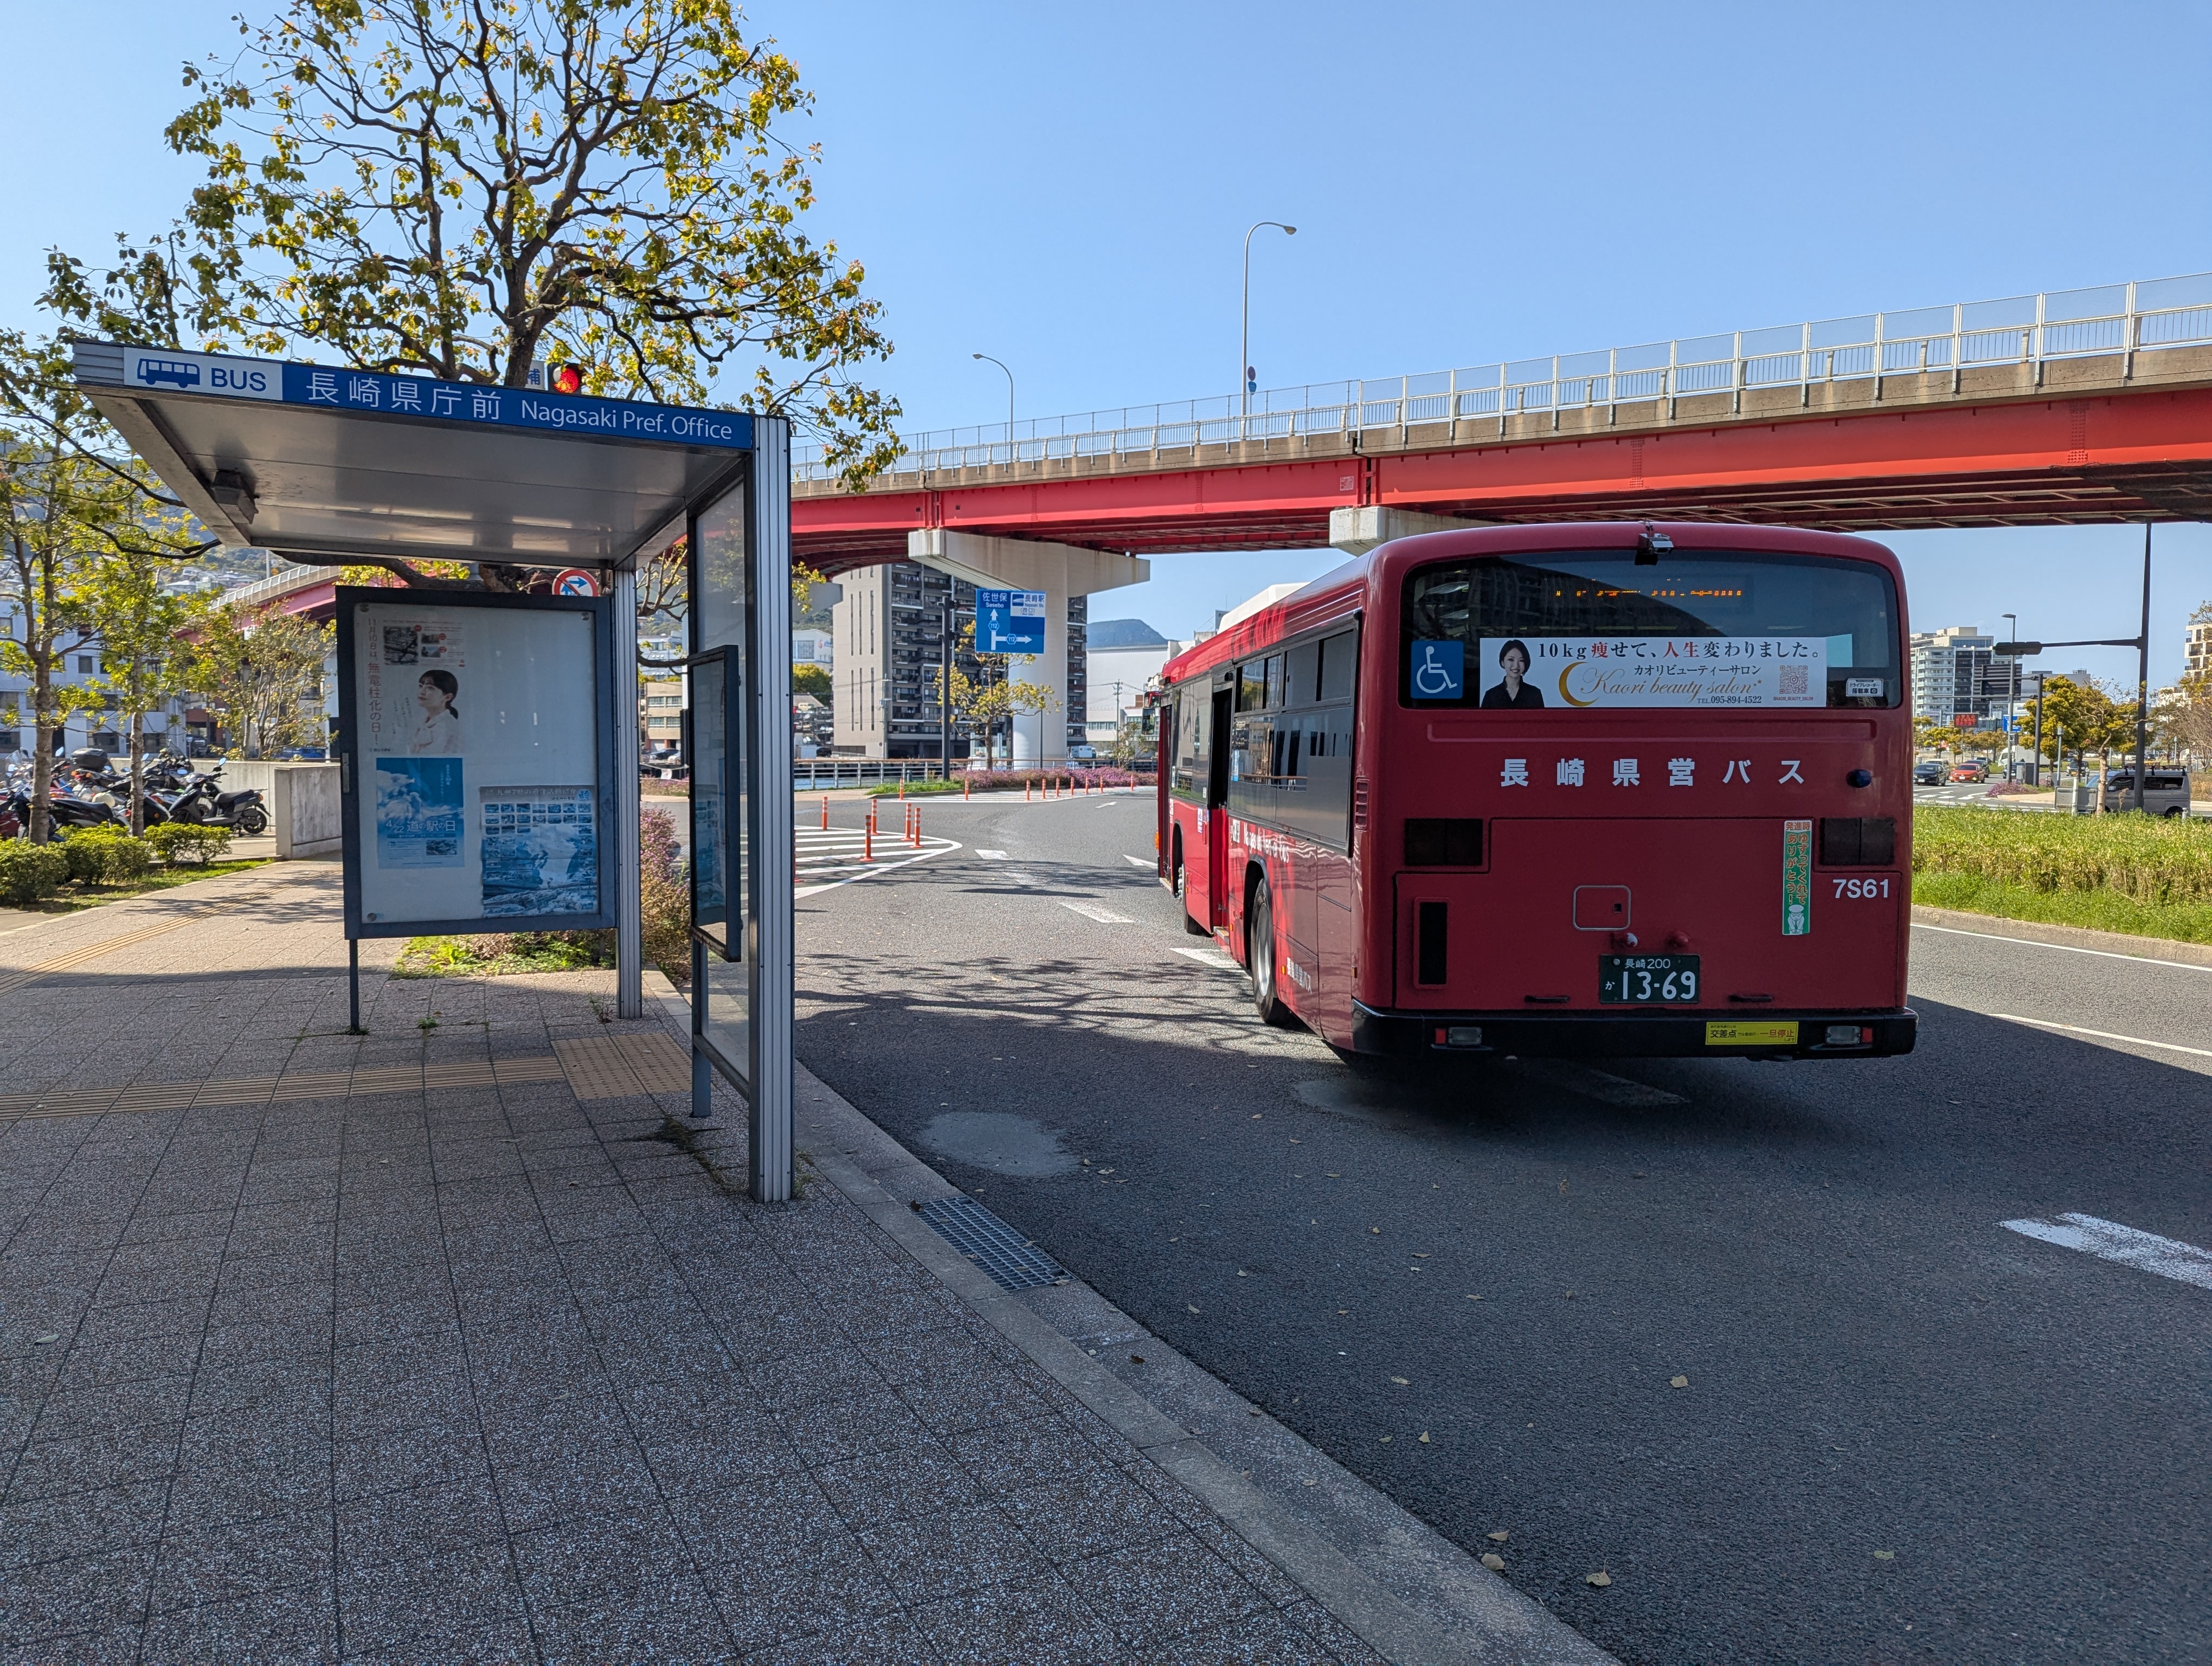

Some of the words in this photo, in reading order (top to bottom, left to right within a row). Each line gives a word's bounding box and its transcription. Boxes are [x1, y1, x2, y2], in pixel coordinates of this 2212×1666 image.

[210, 368, 266, 392] BUS
[306, 372, 502, 420] 長崎県庁前
[521, 400, 617, 428] Nagasaki
[623, 411, 668, 434] Pref.
[672, 416, 732, 440] Office
[982, 592, 1007, 602] 佐世保
[1539, 641, 1818, 660] 10kg痩せて、人生変わりました。
[1634, 664, 1761, 676] カオリビューティーサロン
[1580, 668, 1647, 694] Kaori
[1650, 677, 1703, 703] beauty
[1707, 676, 1752, 694] salon
[1500, 759, 1804, 787] 長崎県営バス
[386, 819, 404, 833] 4/22
[407, 821, 455, 831] 道の駅の日
[1786, 822, 1811, 831] 発進時
[1786, 834, 1797, 904] ありがとう！
[1797, 834, 1809, 904] ゆずってくれて
[1833, 879, 1888, 898] 7S61
[1605, 981, 1615, 990] か
[1623, 971, 1695, 999] 13-69
